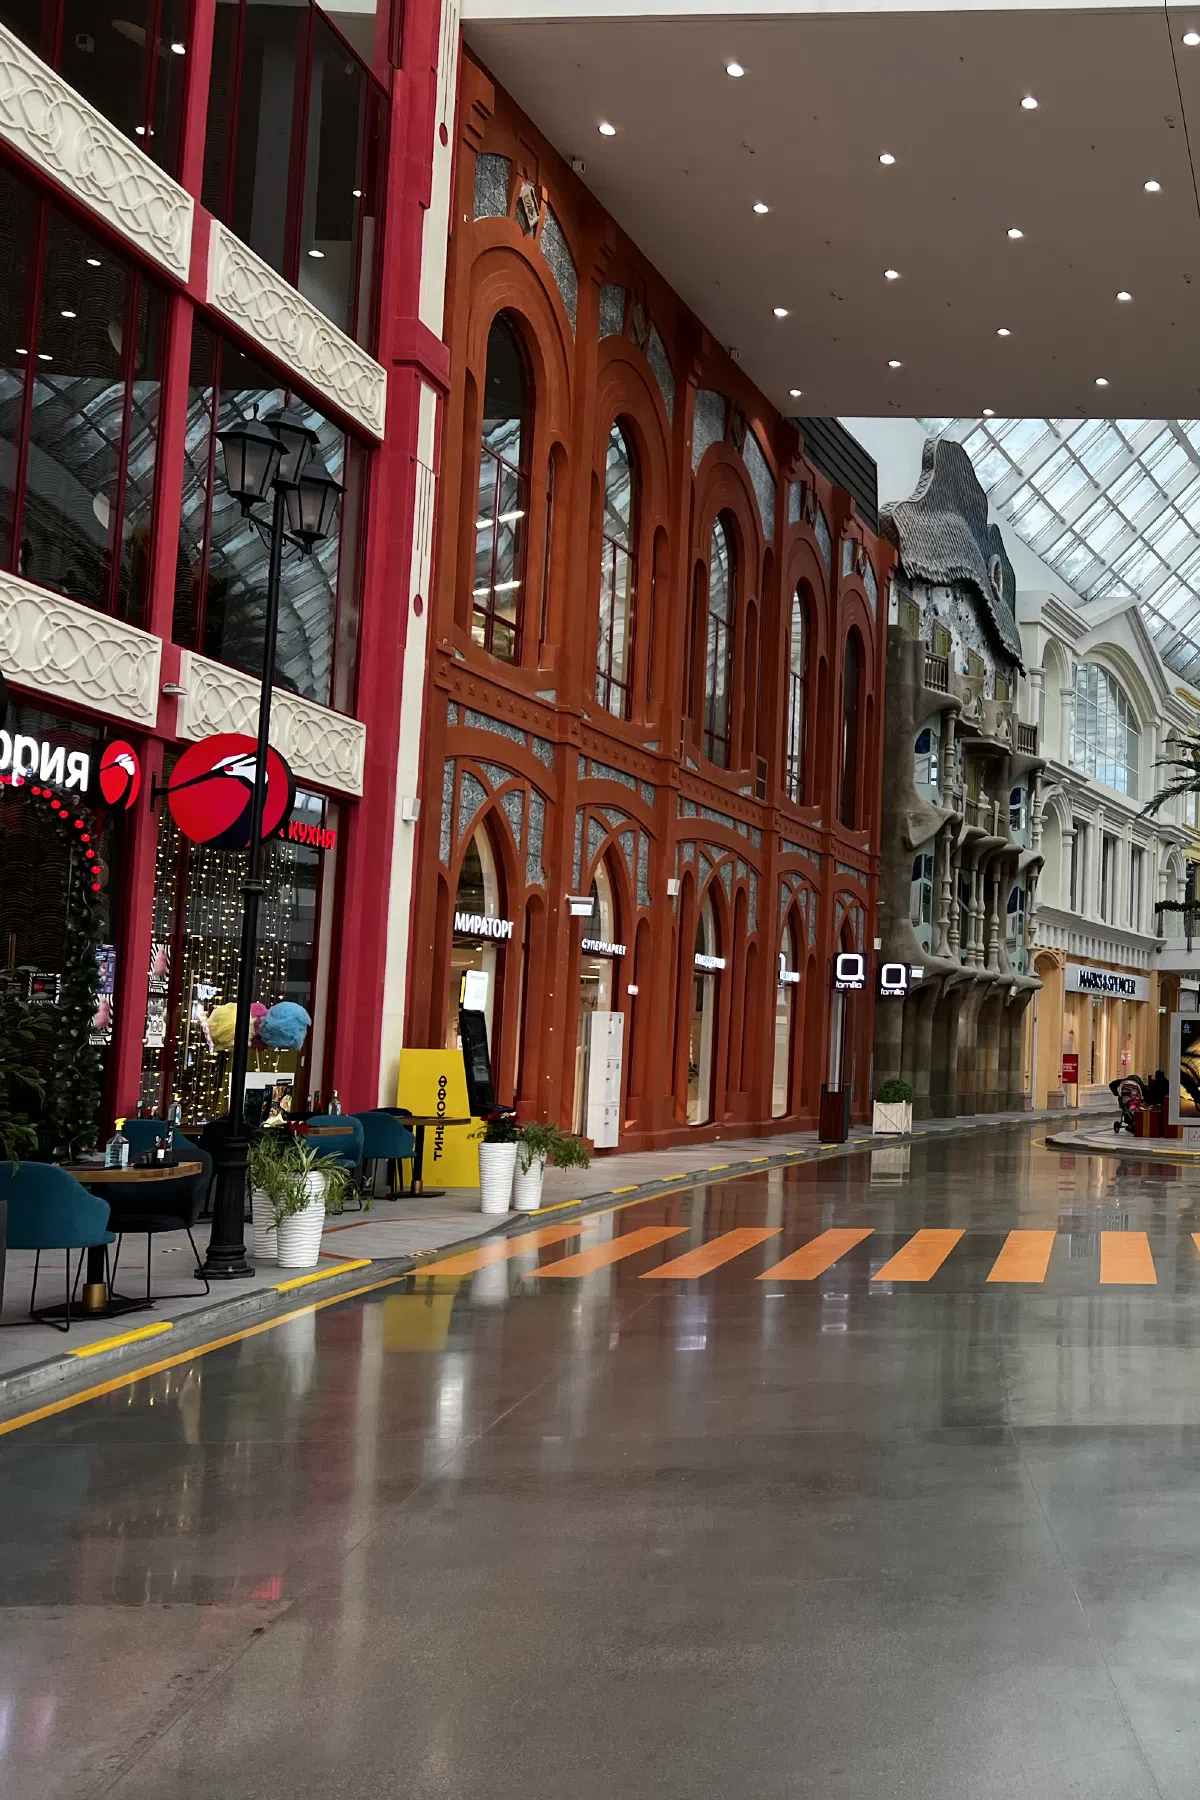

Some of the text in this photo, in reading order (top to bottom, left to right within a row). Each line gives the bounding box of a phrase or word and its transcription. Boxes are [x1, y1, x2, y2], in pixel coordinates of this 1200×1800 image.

[289, 820, 336, 849] КУХНЯ
[454, 912, 514, 938] МИРАТОРГ
[581, 938, 627, 956] СУПЕРМАРКЕТ
[835, 980, 862, 989] familia
[880, 988, 905, 996] familia
